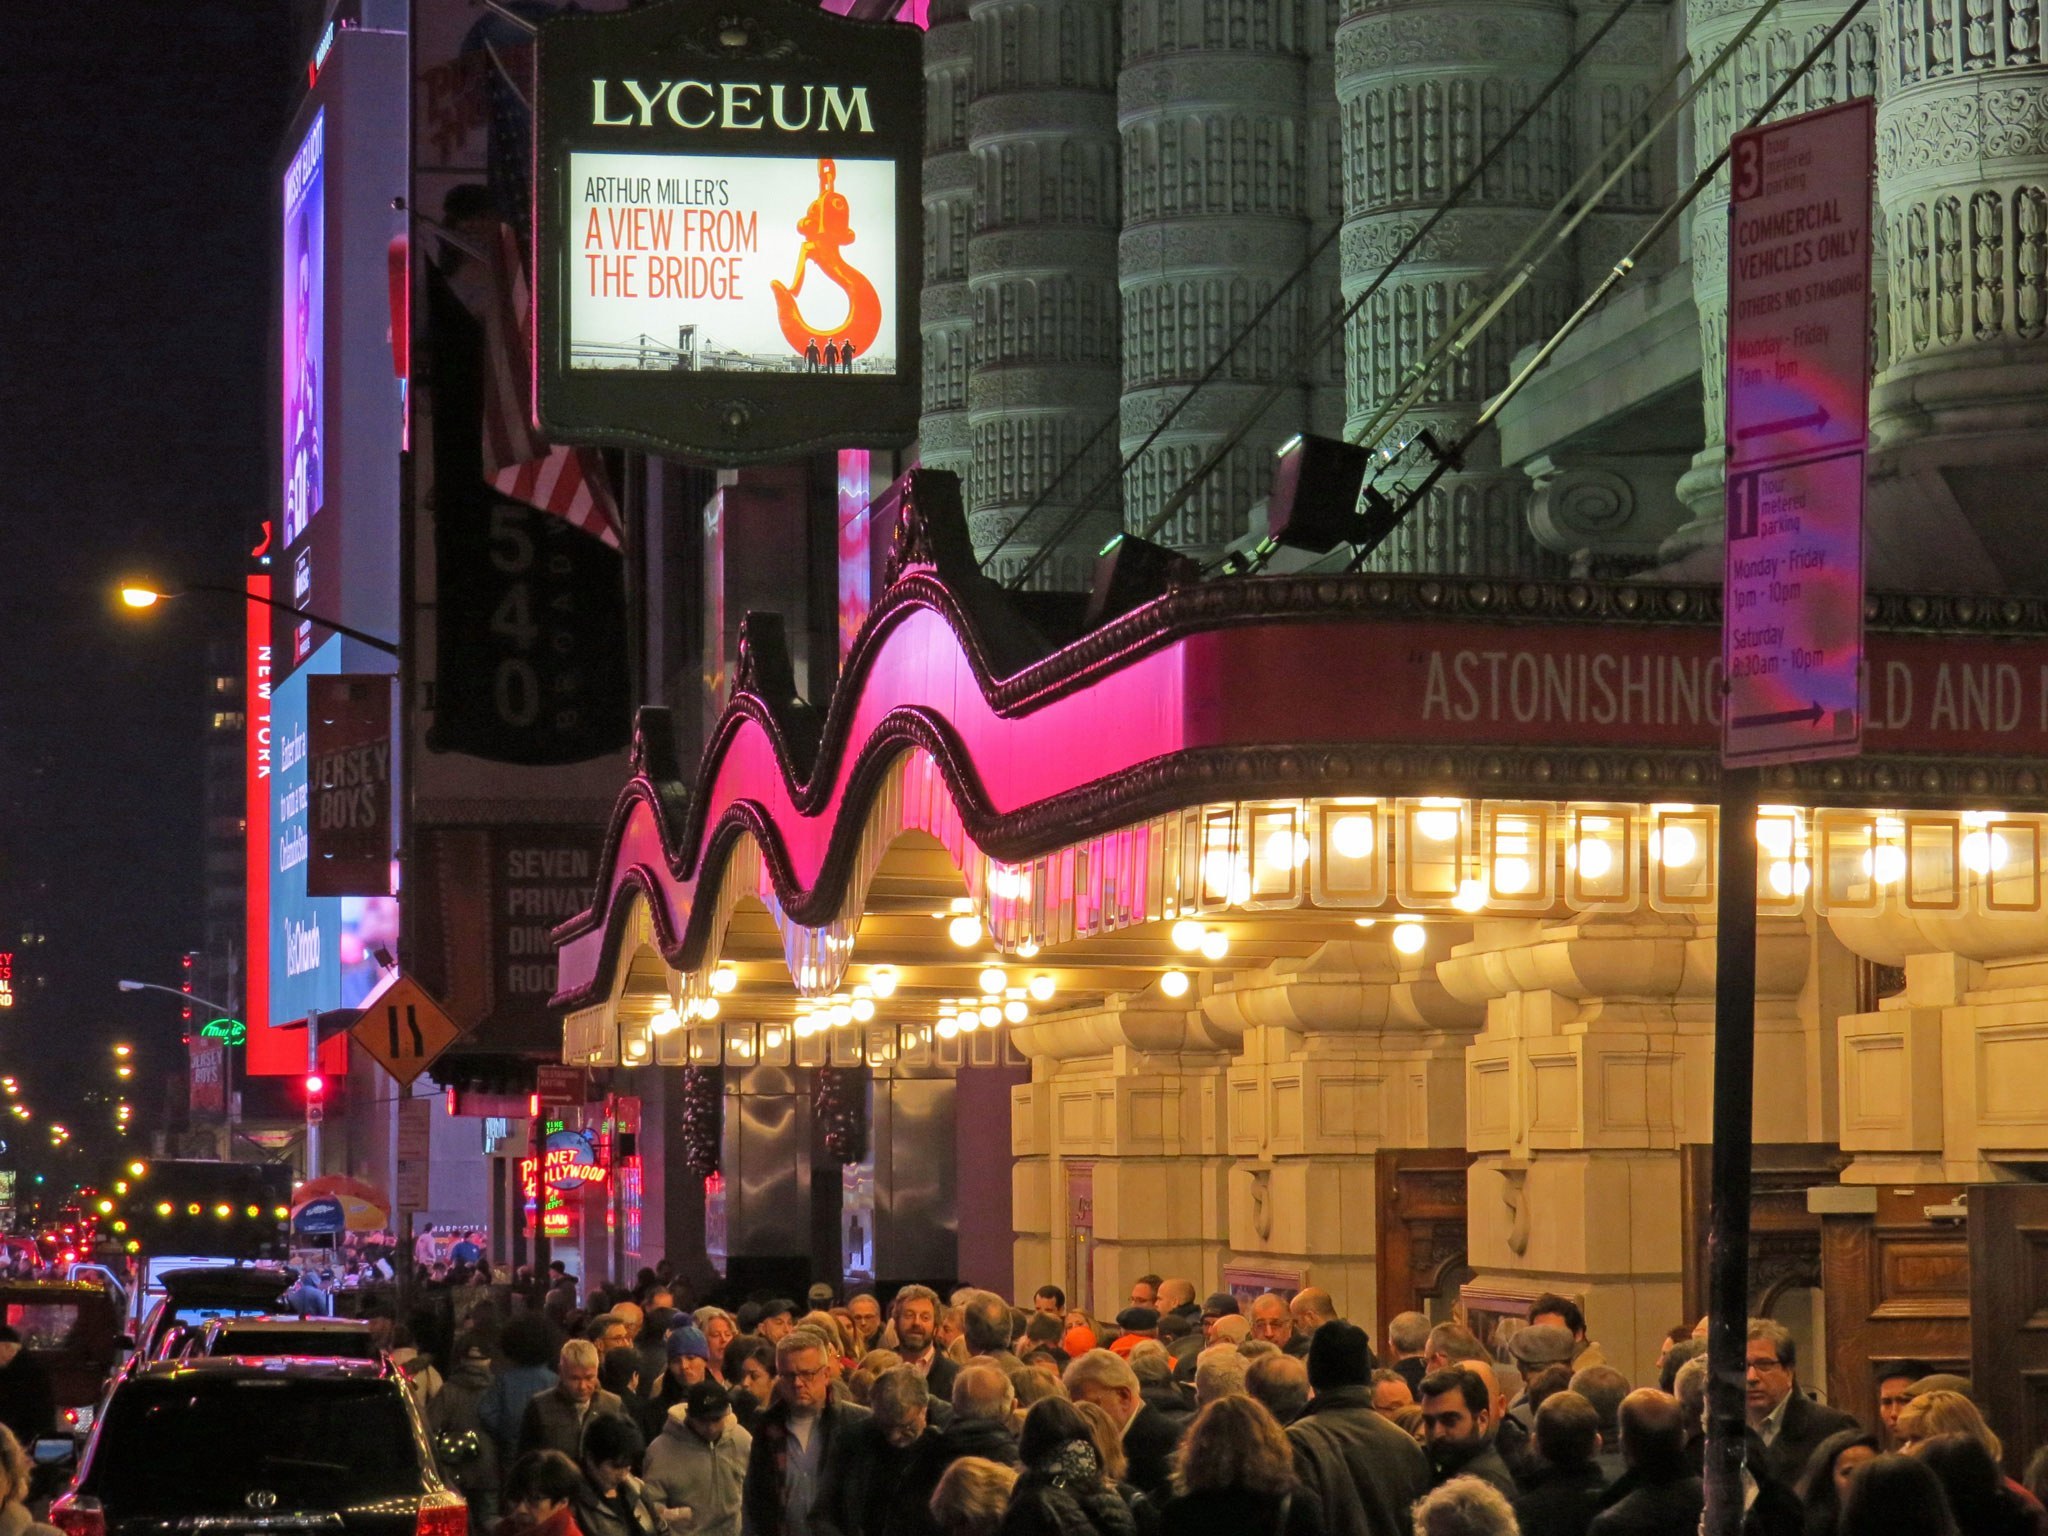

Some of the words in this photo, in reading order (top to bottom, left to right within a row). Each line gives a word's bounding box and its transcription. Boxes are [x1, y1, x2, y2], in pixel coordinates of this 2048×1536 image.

[592, 79, 874, 132] LYCEUM
[1737, 139, 1759, 198] 3
[585, 176, 651, 204] ARTHUR
[658, 178, 729, 206] MILLER'S
[585, 208, 603, 251] A
[608, 208, 673, 252] VIEW
[683, 210, 758, 252] FROM
[1739, 199, 1842, 247] COMMERCIAL
[1739, 240, 1812, 281] VEHICLES
[1818, 228, 1859, 263] ONLY
[585, 254, 638, 298] THE
[648, 257, 743, 300] BRIDGE
[1738, 291, 1782, 321] OTHERS
[1785, 287, 1800, 309] NO
[1804, 273, 1863, 306] STANDING
[1737, 334, 1782, 361] Monday
[1794, 322, 1830, 347] Friday
[1736, 367, 1762, 389] 7am
[1775, 359, 1798, 380] 1pm
[1762, 476, 1785, 497] hour
[1736, 478, 1749, 535] 1
[1761, 491, 1806, 516] metered
[1761, 516, 1801, 539] parking
[1734, 556, 1778, 581] Monday
[1790, 548, 1825, 572] Friday
[1734, 588, 1756, 612] 1pm
[1769, 582, 1801, 604] 10pm
[1734, 624, 1785, 650] Saturday
[258, 646, 271, 700] NEW
[1791, 648, 1824, 673] 10pm
[1860, 661, 1913, 729] LD
[1930, 663, 2022, 733] AND
[311, 743, 389, 792] JERSEY
[319, 787, 376, 830] BOYS
[508, 849, 589, 878] SEVEN
[508, 888, 593, 916] PRIVAT
[508, 927, 557, 954] DIN
[508, 965, 558, 993] ROO
[207, 1023, 241, 1037] Muic
